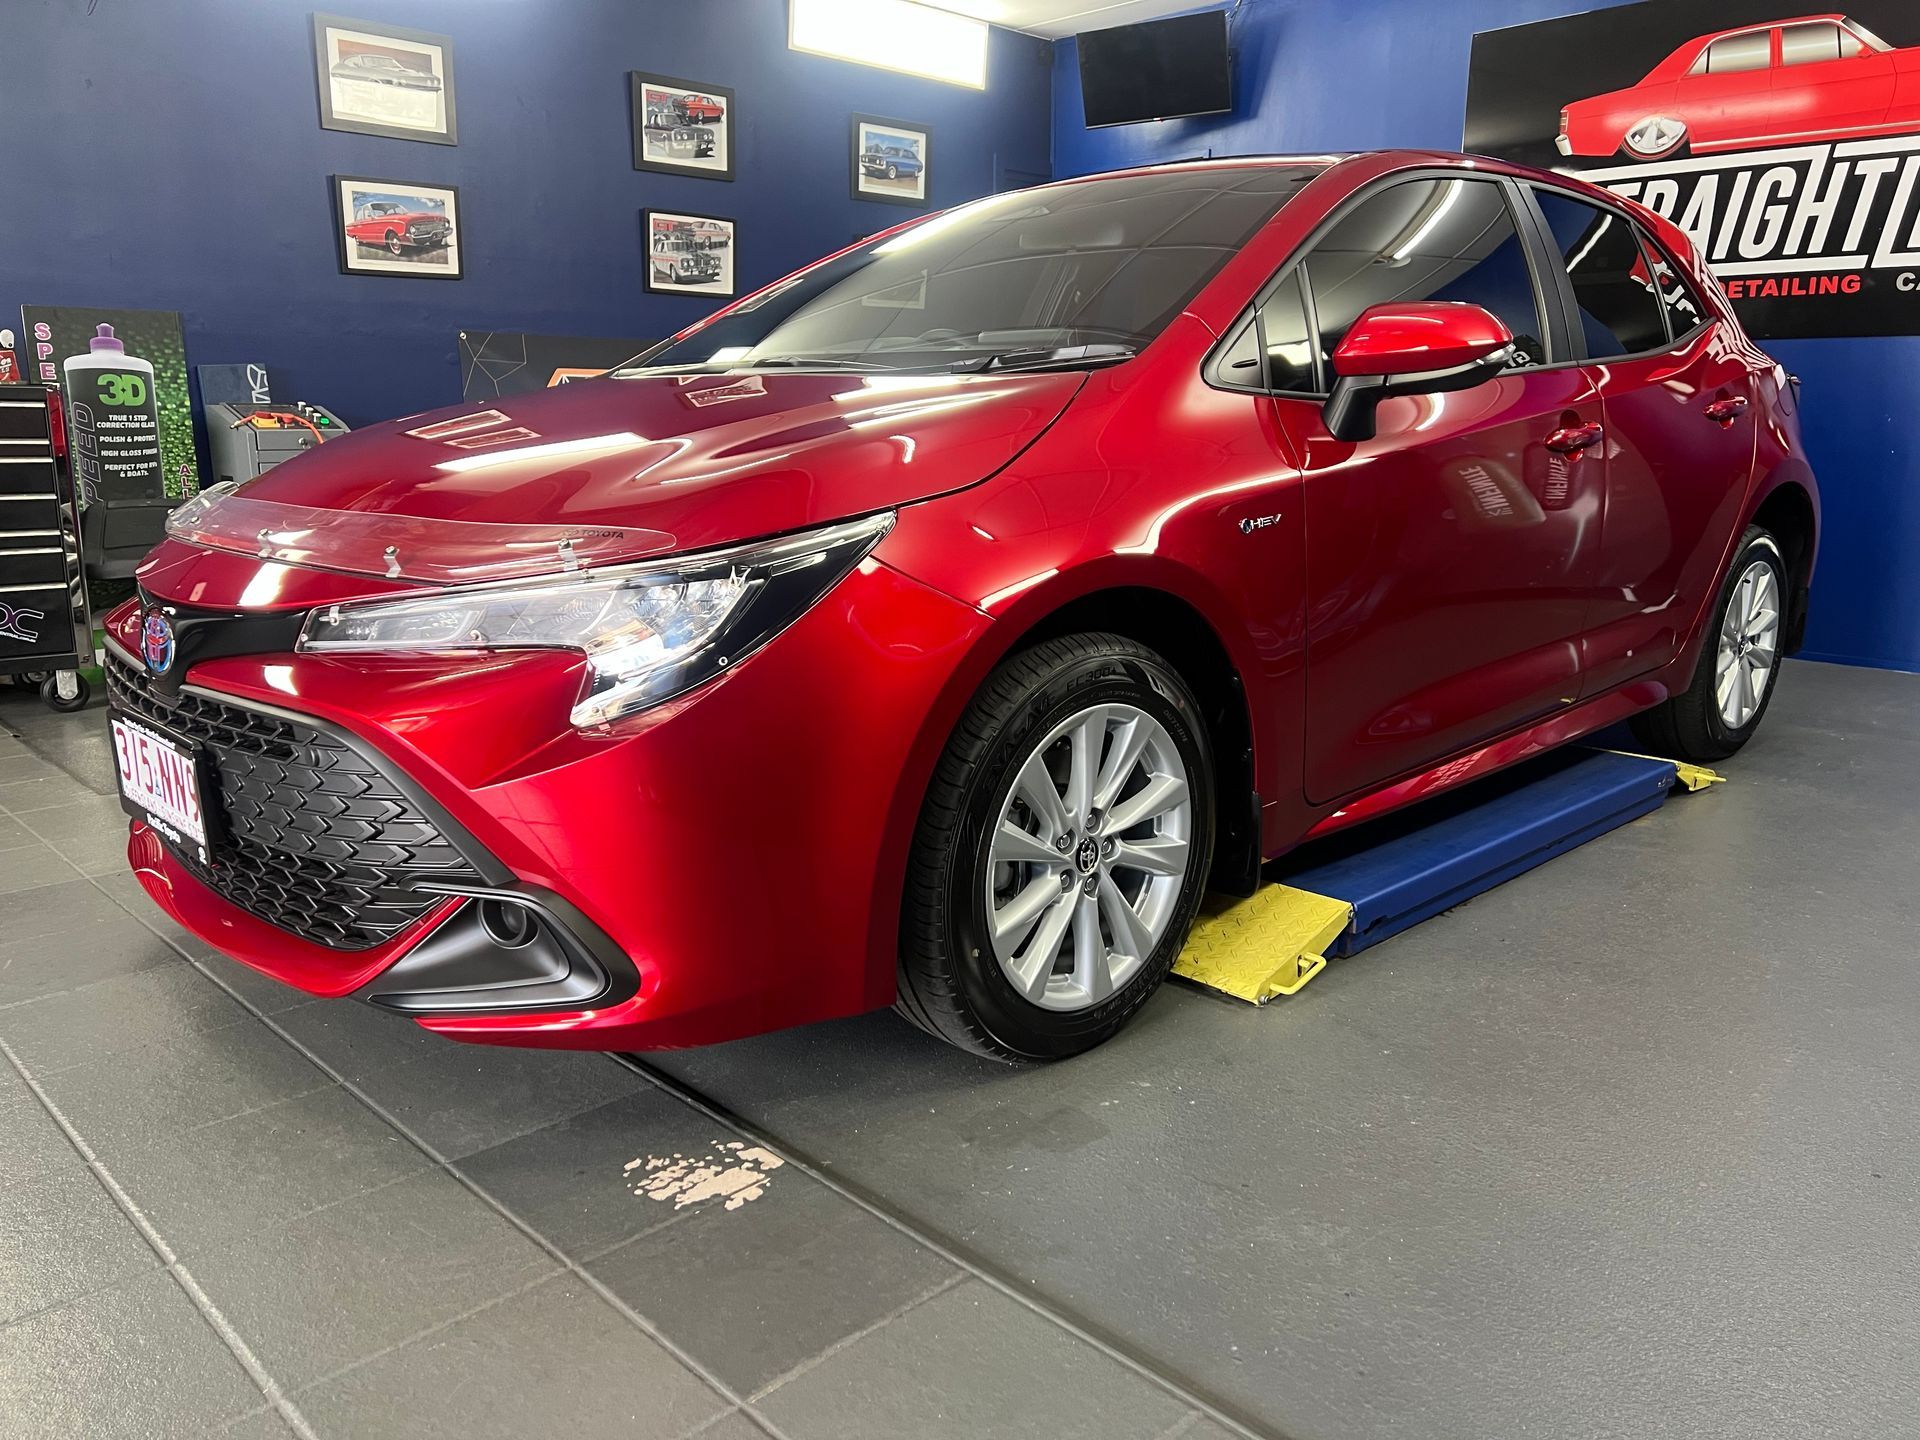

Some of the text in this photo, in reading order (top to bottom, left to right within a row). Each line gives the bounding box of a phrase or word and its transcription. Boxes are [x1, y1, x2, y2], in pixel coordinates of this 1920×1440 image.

[1719, 275, 1860, 298] ETAILING
[34, 322, 60, 390] SPE
[97, 373, 146, 406] 3D
[96, 421, 140, 429] CORRECTION
[99, 435, 126, 443] POLISH
[120, 449, 142, 457] GLOSS
[136, 462, 149, 470] FOR
[582, 529, 624, 539] TOYOTA
